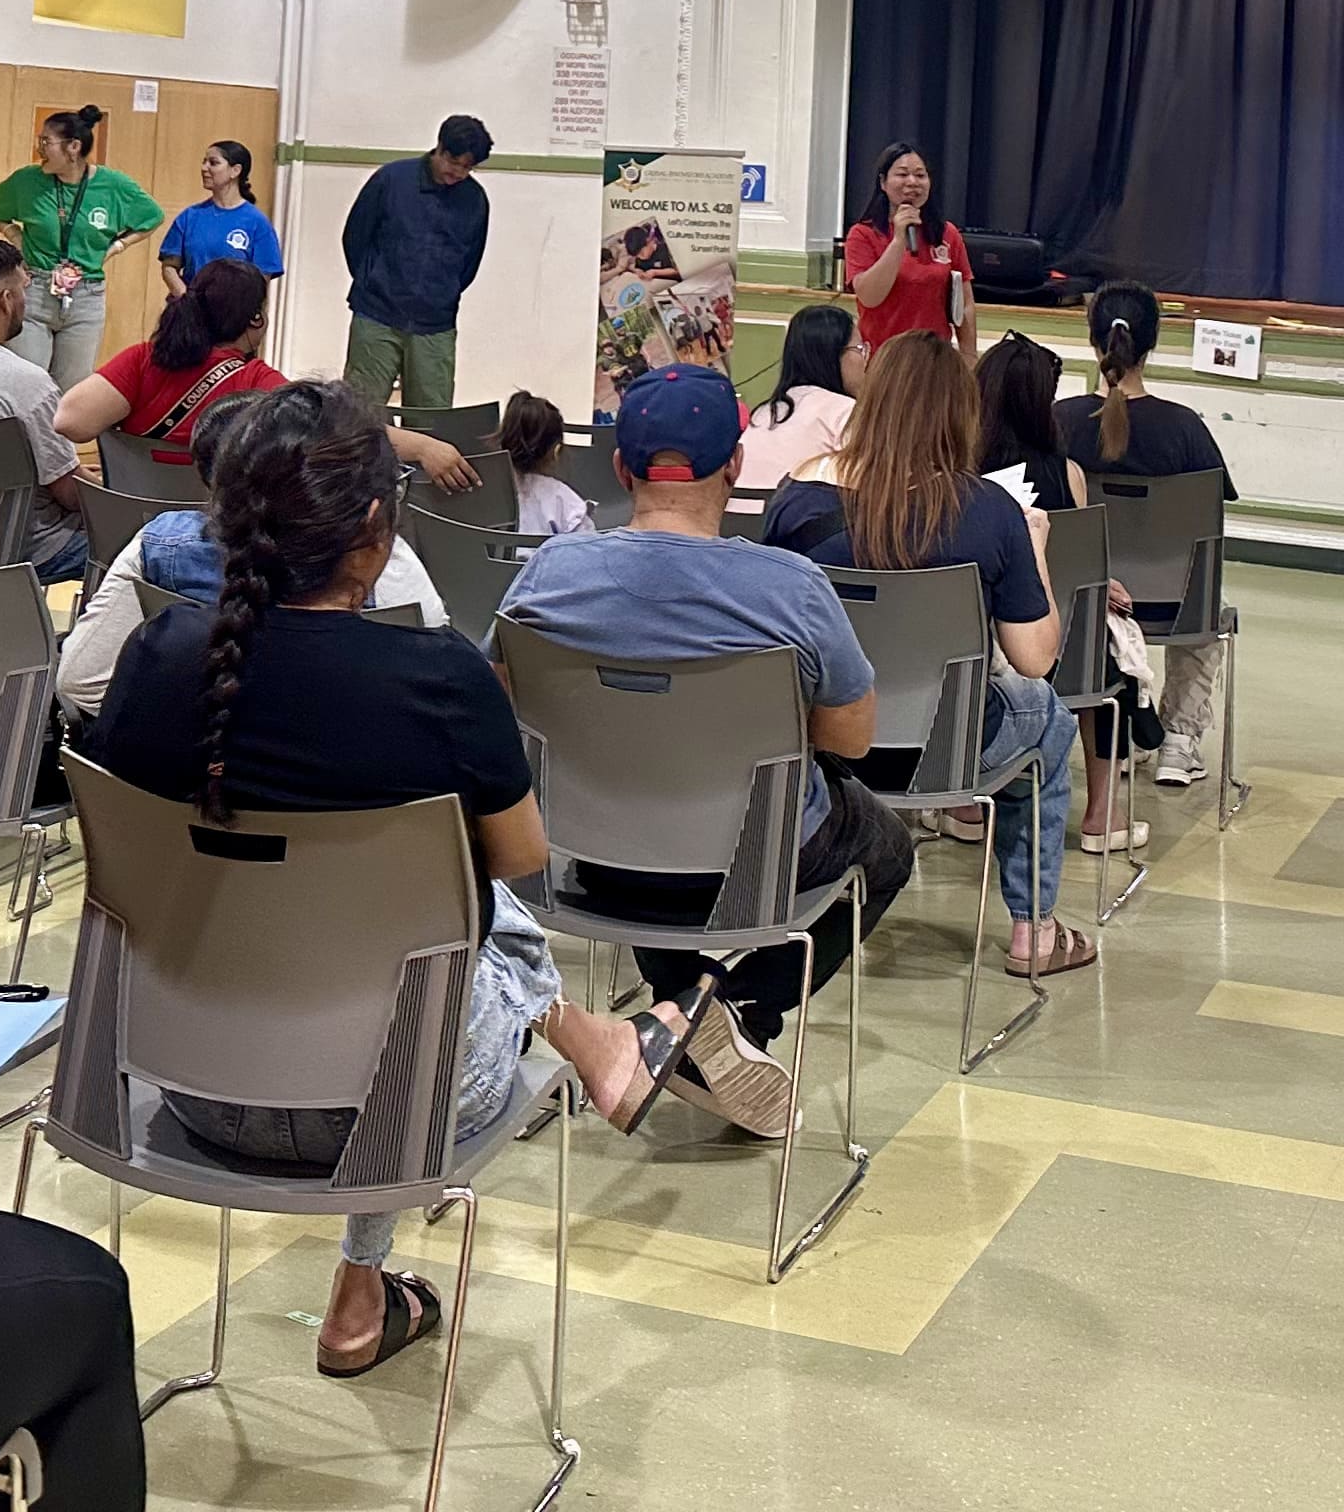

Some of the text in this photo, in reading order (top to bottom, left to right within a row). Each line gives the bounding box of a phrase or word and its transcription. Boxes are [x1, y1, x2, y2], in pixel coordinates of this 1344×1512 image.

[560, 52, 602, 60] OCCUPANCY
[560, 116, 603, 124] DANGEROUS
[610, 199, 733, 214] WELCOME TO M.S. 428
[667, 232, 694, 240] Cultures
[182, 382, 209, 409] LOUIS
